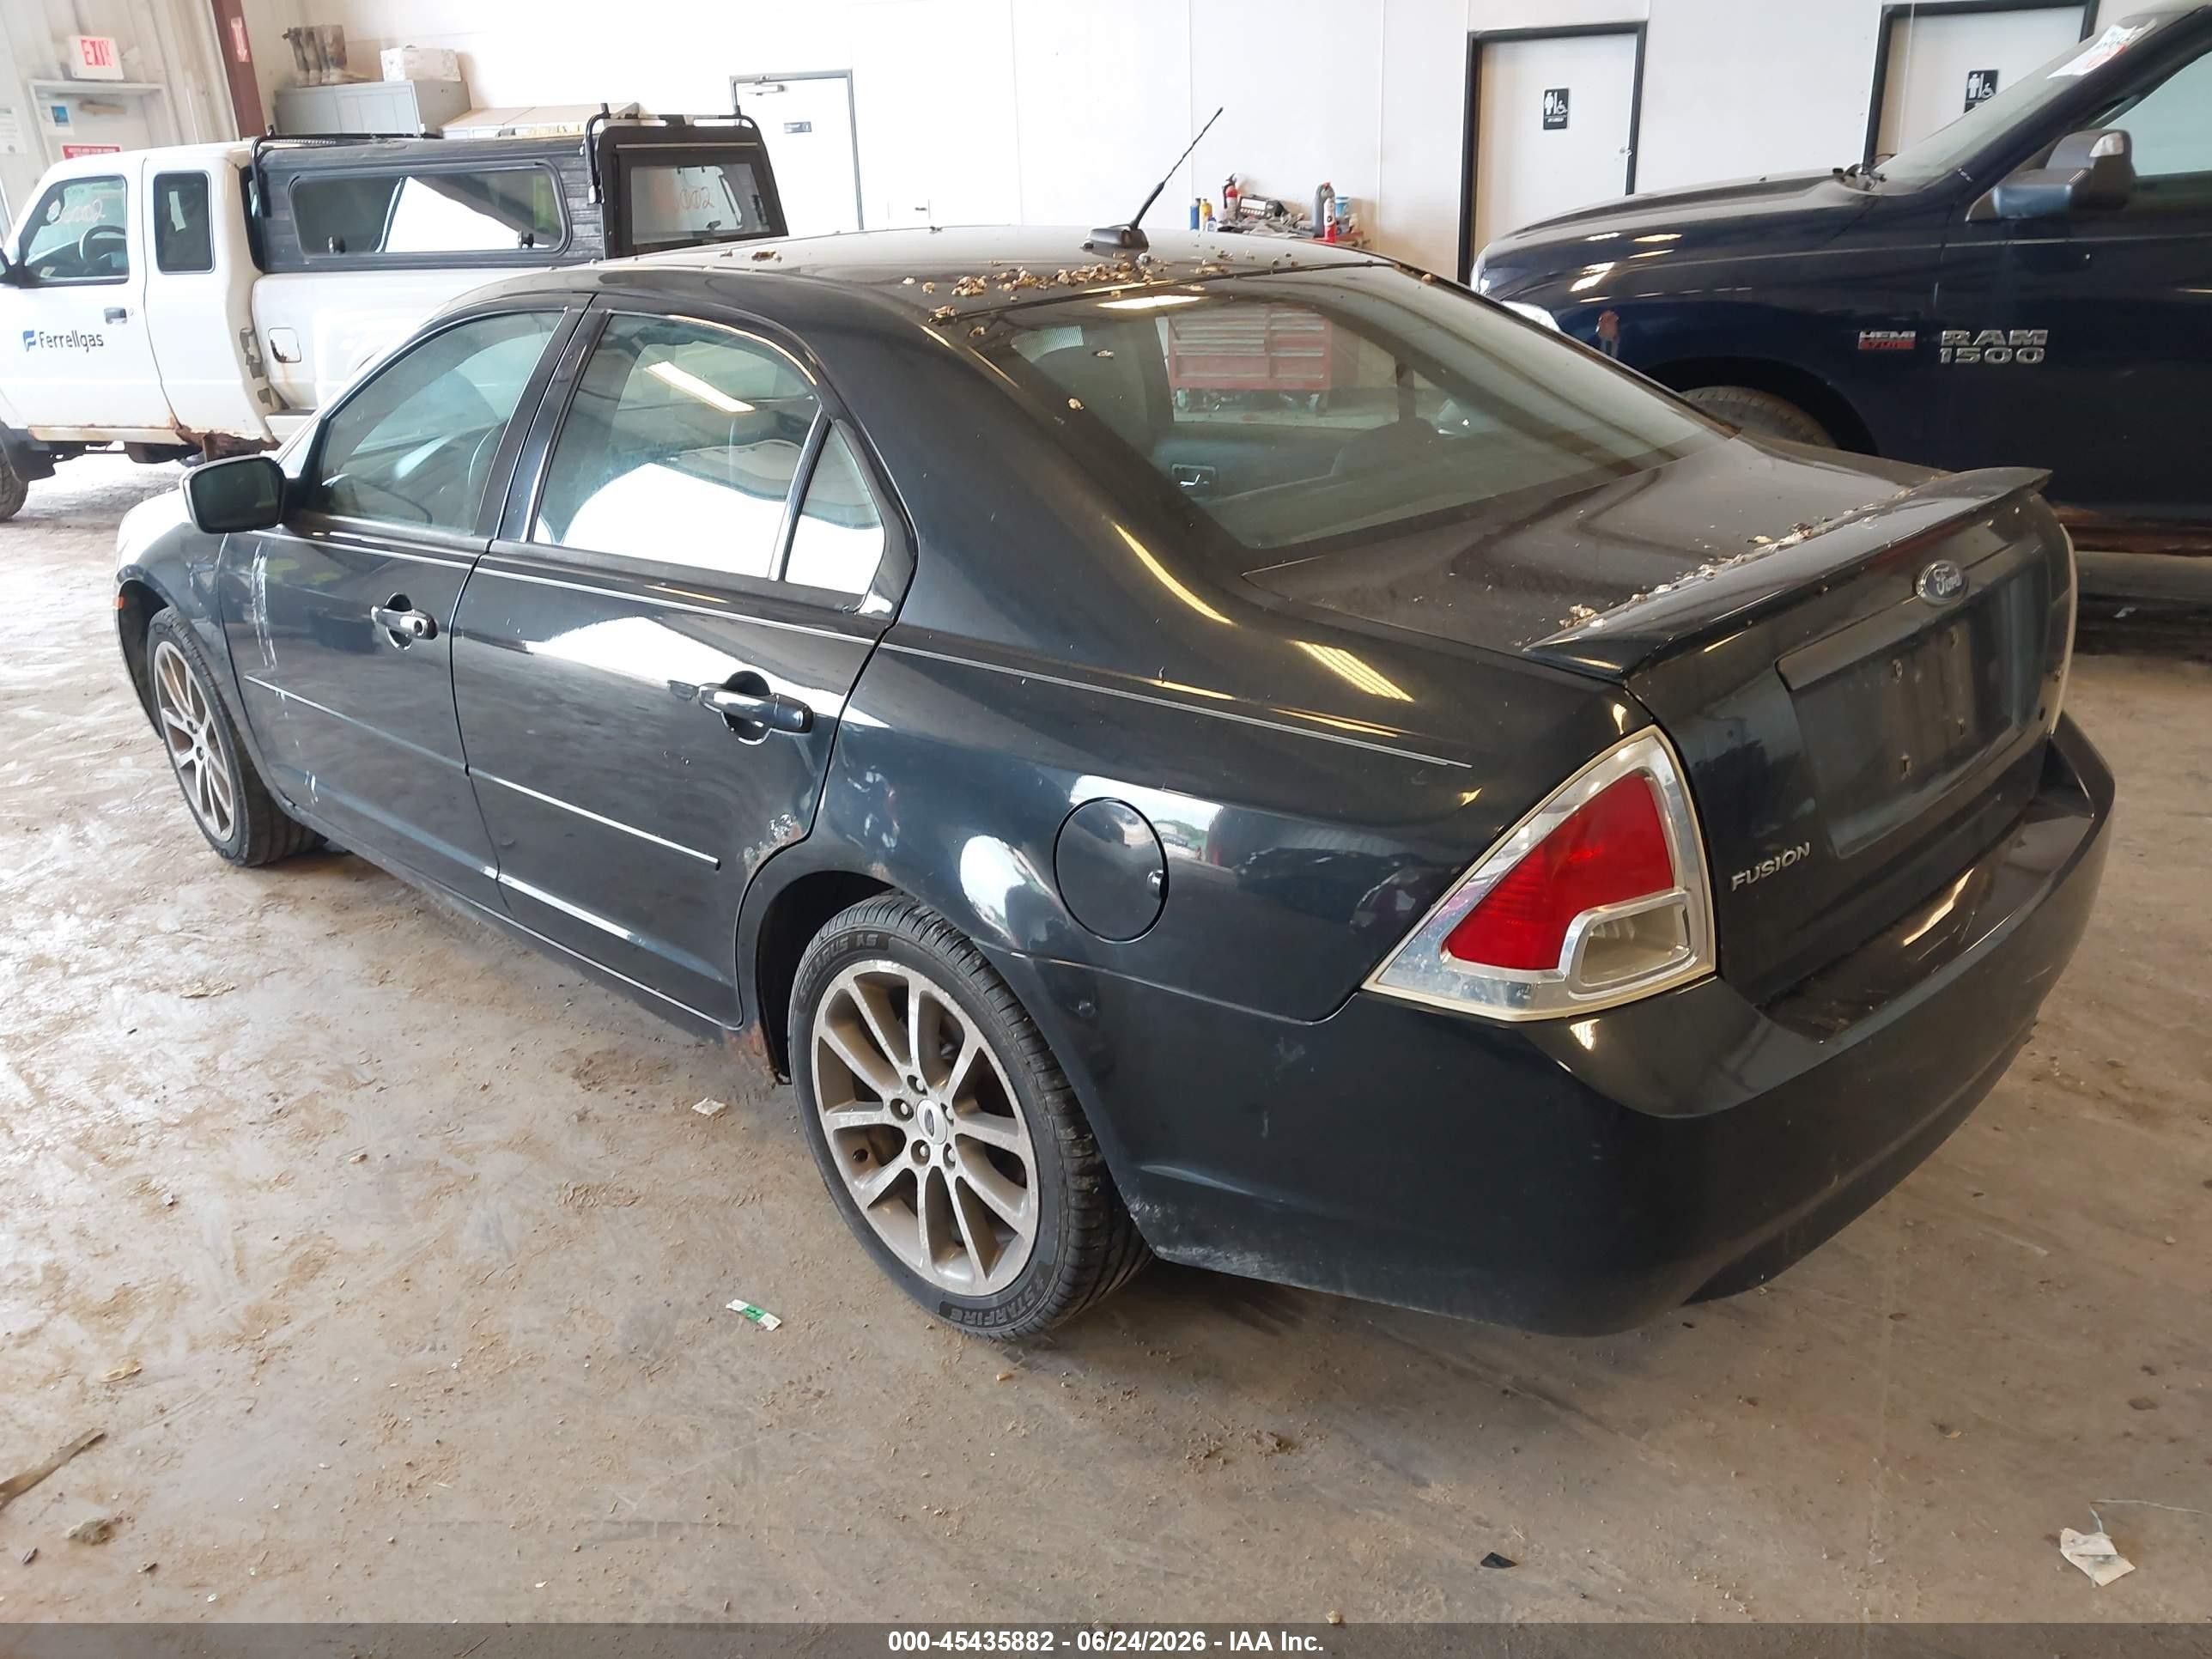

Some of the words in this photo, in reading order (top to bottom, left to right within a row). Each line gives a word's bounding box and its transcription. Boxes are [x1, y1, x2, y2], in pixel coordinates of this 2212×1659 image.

[39, 329, 104, 353] Ferrellgas
[1859, 330, 1917, 342] HEMI
[1940, 330, 2049, 346] RAM
[1939, 347, 2046, 364] 1500
[1932, 566, 1963, 596] Ford
[1731, 842, 1810, 892] FUSION
[950, 1285, 1036, 1325] STARFIRE
